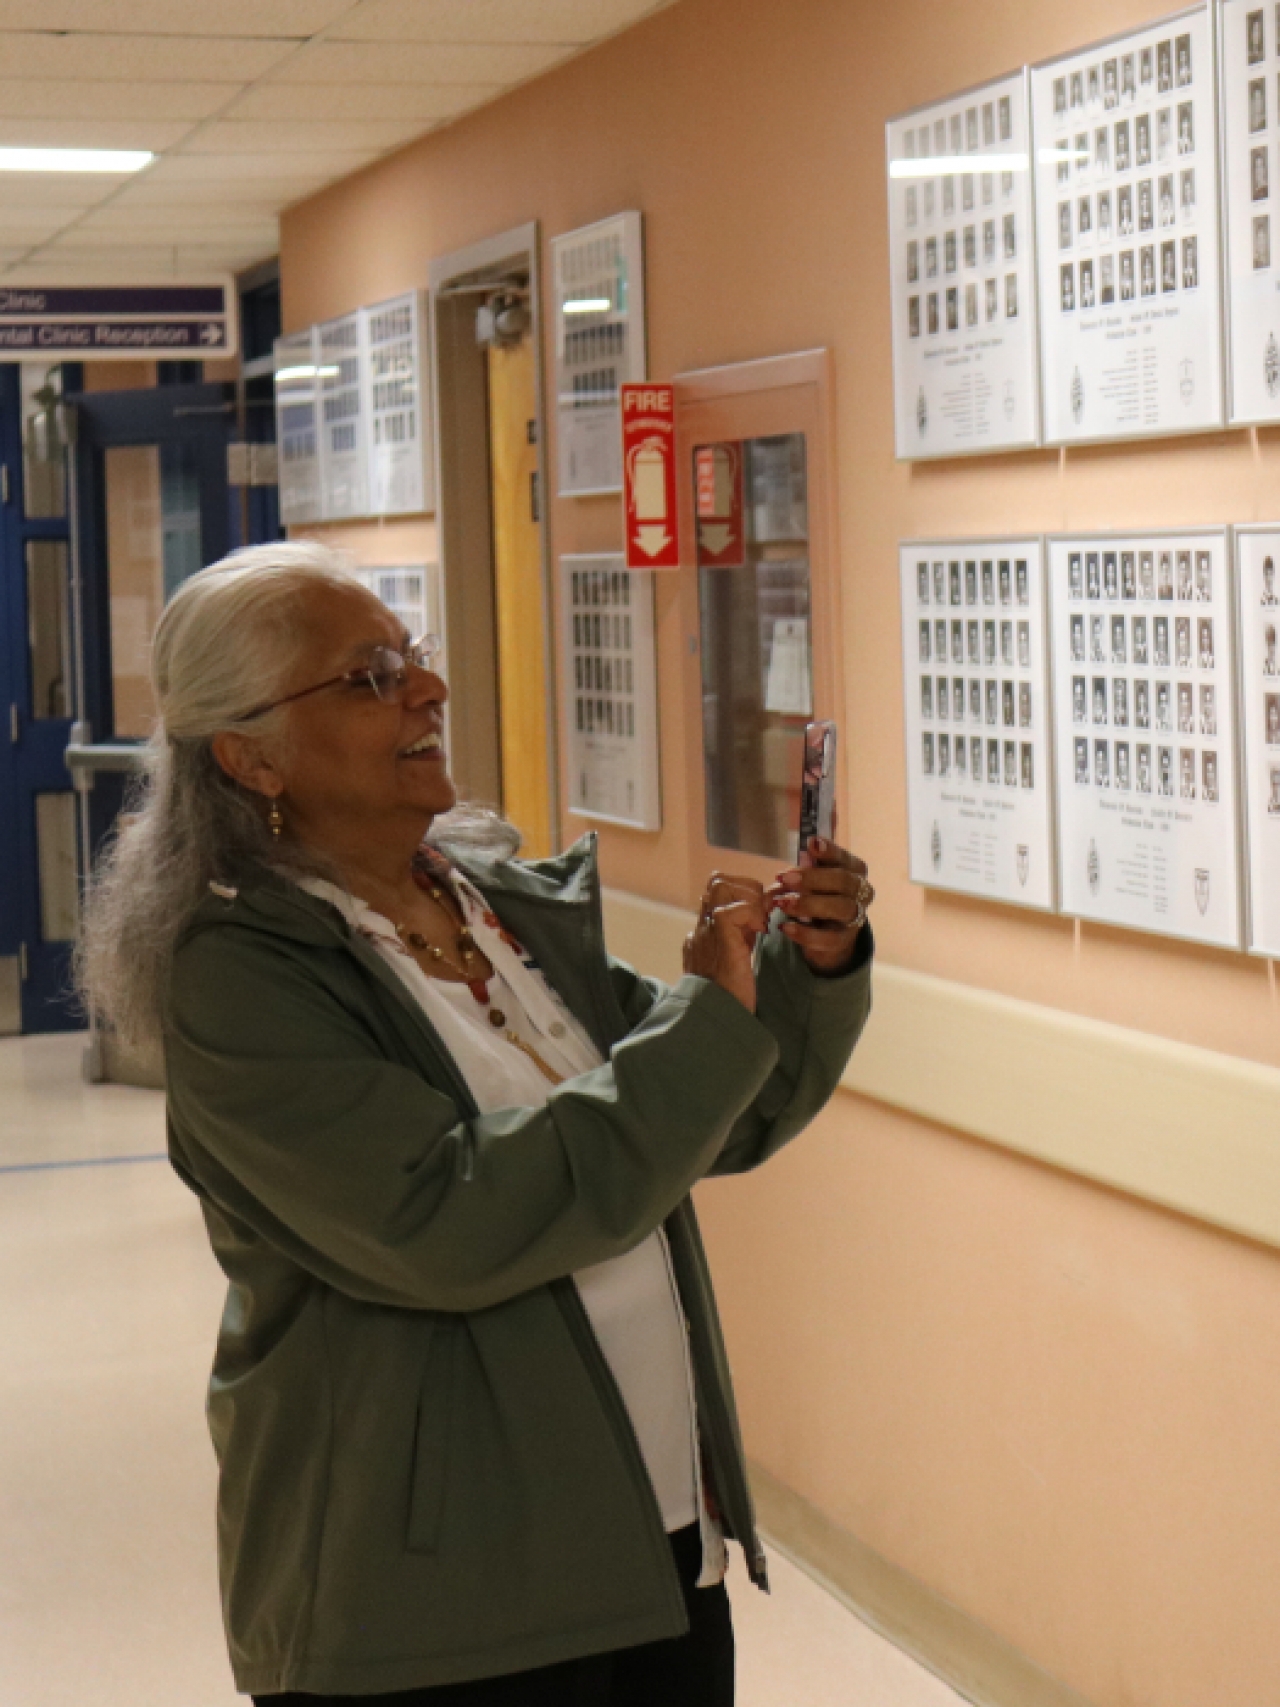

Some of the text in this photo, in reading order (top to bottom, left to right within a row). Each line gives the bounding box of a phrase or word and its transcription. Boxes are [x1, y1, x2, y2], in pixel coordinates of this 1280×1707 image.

[37, 324, 90, 345] Clinic
[95, 324, 189, 347] Reception
[624, 389, 672, 413] FIRE
